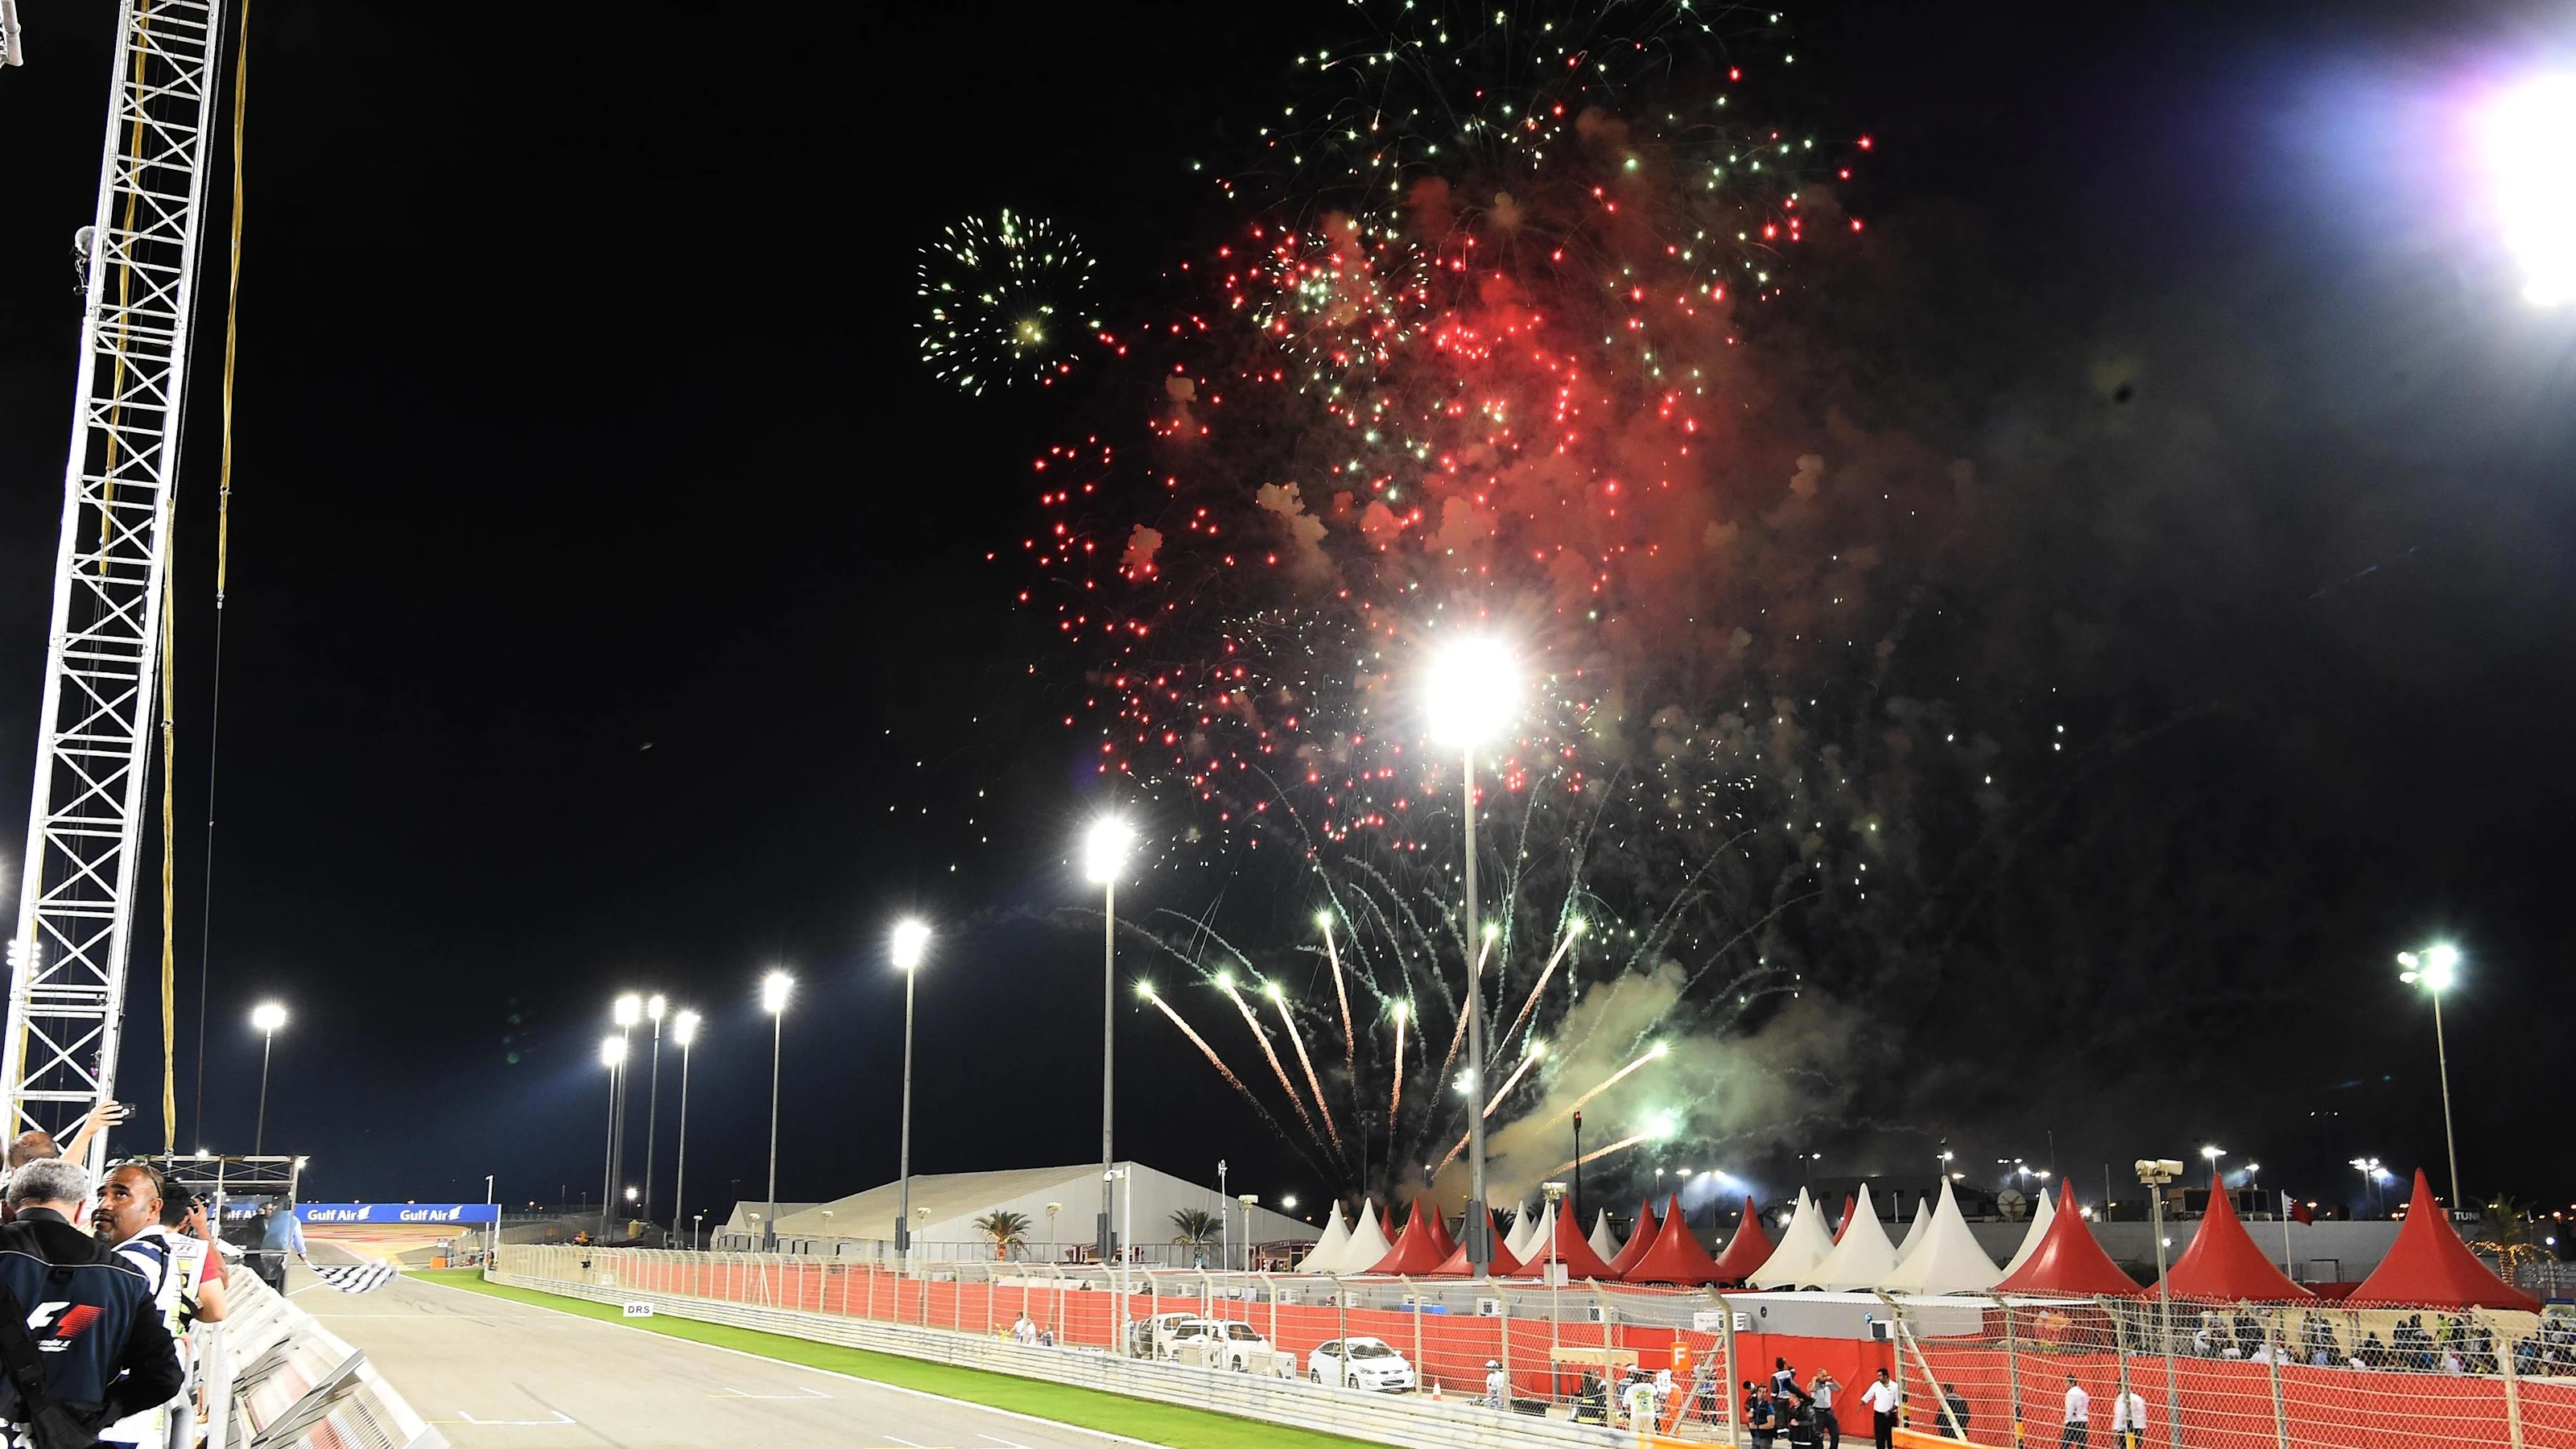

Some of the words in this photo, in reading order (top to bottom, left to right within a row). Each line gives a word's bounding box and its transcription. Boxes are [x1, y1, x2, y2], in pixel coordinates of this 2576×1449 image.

[307, 1209, 336, 1220] Gulf
[336, 1209, 357, 1220] Air
[400, 1210, 428, 1220] Gulf
[428, 1210, 448, 1220] Air
[628, 1306, 650, 1314] DRS
[1674, 1348, 1686, 1366] F
